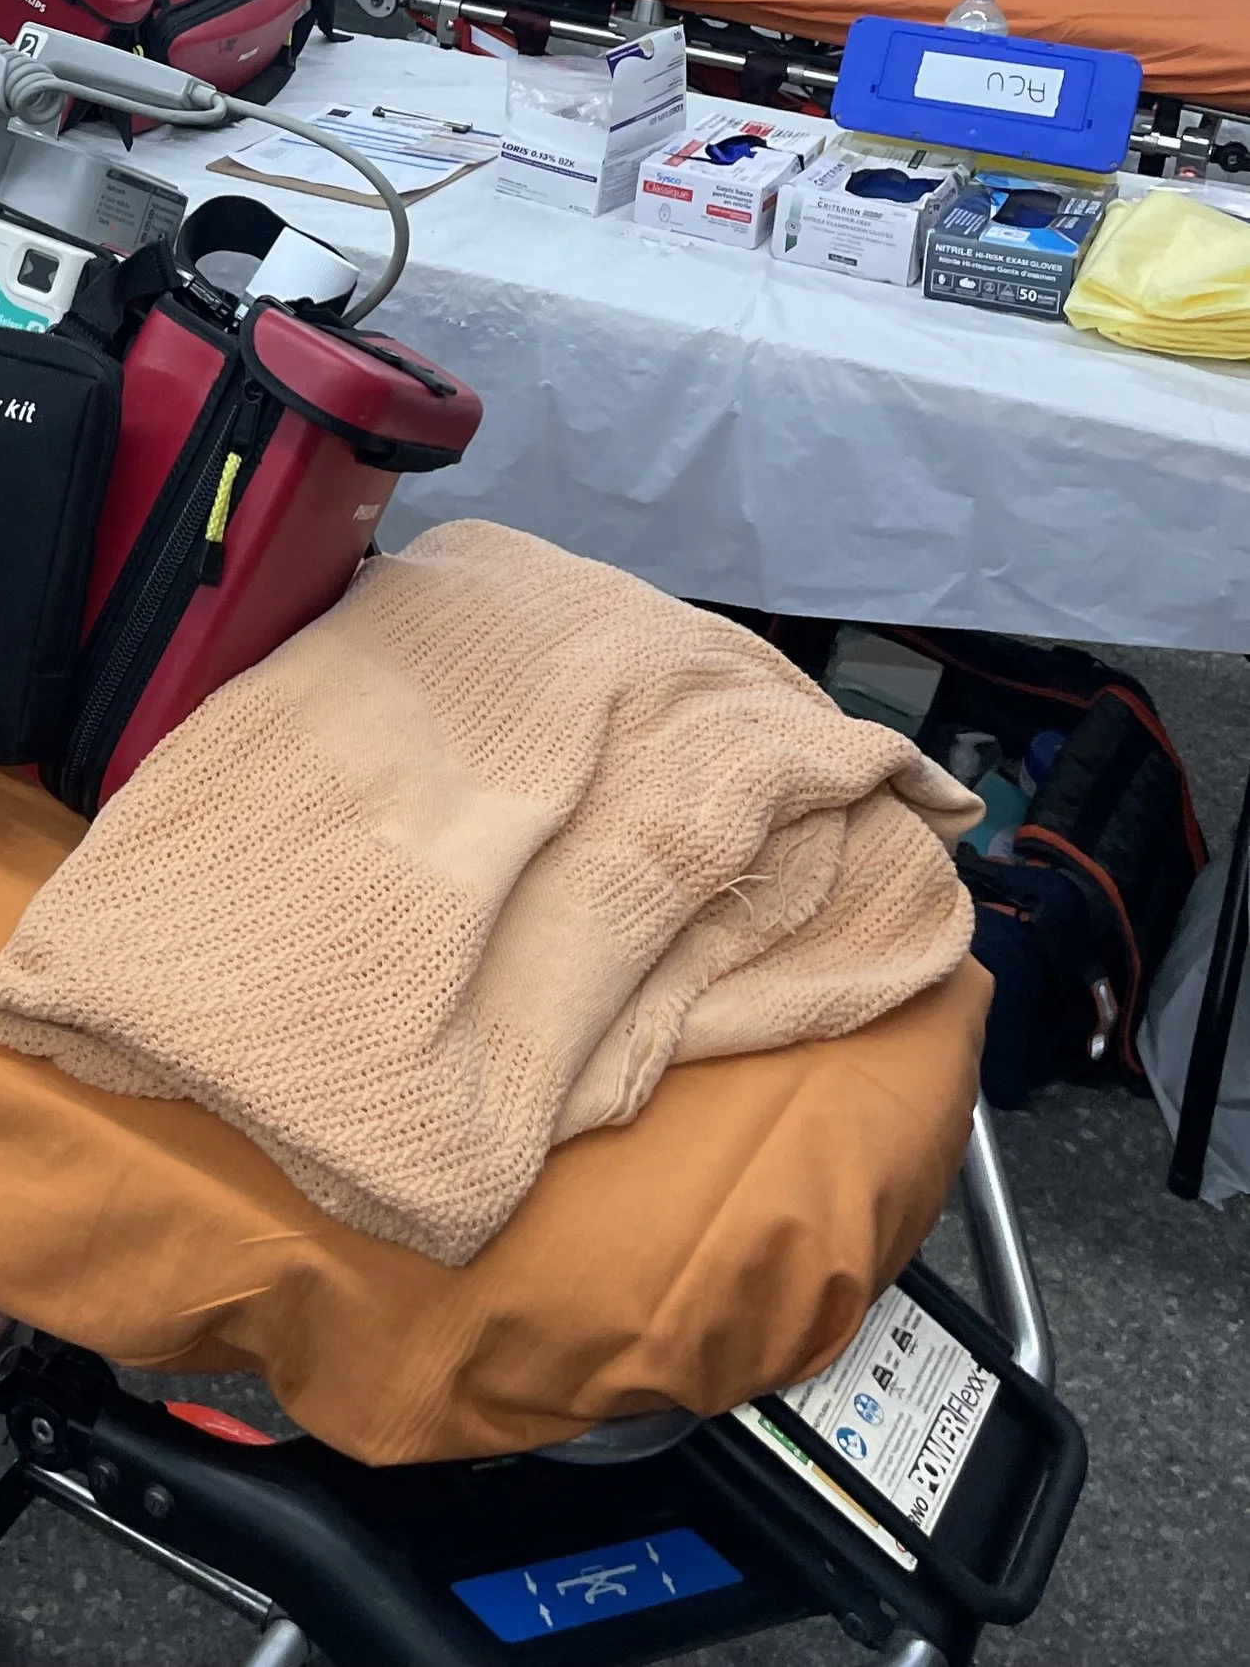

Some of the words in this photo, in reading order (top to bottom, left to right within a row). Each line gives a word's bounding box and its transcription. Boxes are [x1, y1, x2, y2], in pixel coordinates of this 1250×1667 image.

[987, 72, 1046, 104] ACU
[502, 141, 529, 156] LORIS
[530, 149, 556, 164] 0.13%
[558, 157, 576, 168] BZK
[656, 172, 682, 185] Sysco
[645, 183, 691, 200] Classique
[817, 201, 861, 217] CRITERION
[935, 242, 973, 257] NITRILE
[975, 251, 1004, 263] HI-RISK
[1005, 256, 1029, 267] EXAM
[1030, 261, 1064, 273] GLOVES
[1019, 287, 1038, 303] 50
[4, 398, 37, 424] kit
